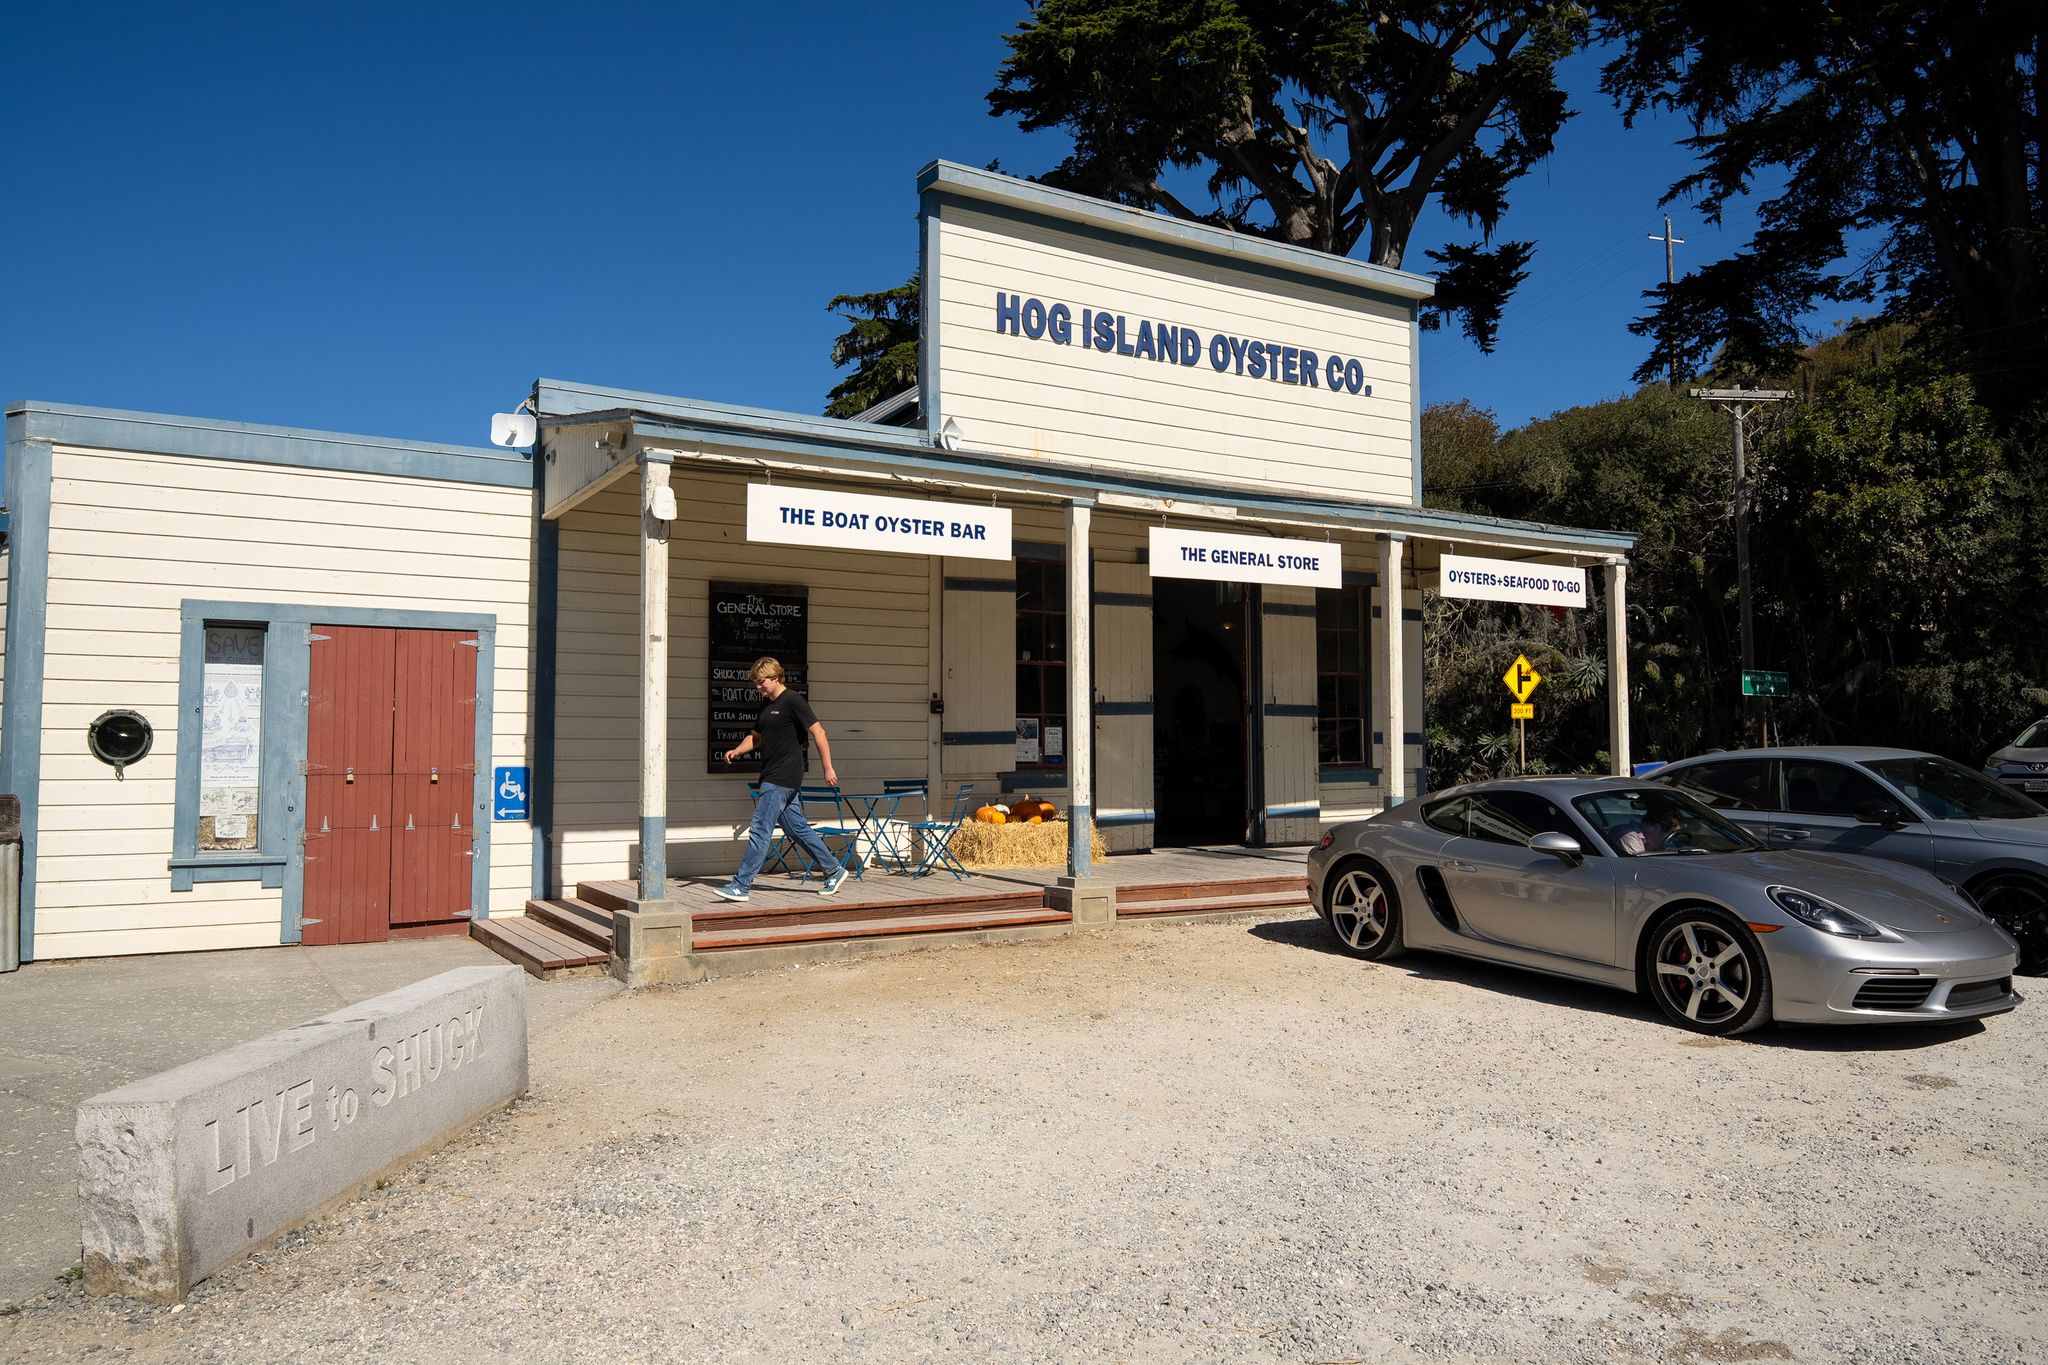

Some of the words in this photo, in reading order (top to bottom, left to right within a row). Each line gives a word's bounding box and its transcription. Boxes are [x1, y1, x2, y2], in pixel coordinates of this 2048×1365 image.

[996, 291, 1072, 346] HOG
[1082, 308, 1202, 367] ISLAND
[1209, 333, 1319, 388] OYSTER
[1326, 355, 1373, 398] CO.
[779, 506, 815, 526] THE
[822, 510, 870, 530] BOAT
[875, 516, 945, 537] OYSTER
[950, 522, 986, 540] BAR
[1180, 546, 1207, 562] THE
[1211, 549, 1274, 567] GENERAL
[1278, 555, 1320, 571] STORE
[1449, 570, 1549, 591] OYSTERS+SEAFOOD
[1552, 580, 1581, 593] TO-GO
[716, 601, 768, 615] GENERAL
[769, 603, 802, 617] STORE
[745, 594, 765, 605] The
[713, 668, 736, 680] SHUCK
[722, 687, 744, 702] BOAT
[713, 711, 736, 720] EXTRA
[204, 1078, 315, 1195] LIVE
[325, 1085, 359, 1132] to
[370, 1004, 486, 1107] SHUCK
